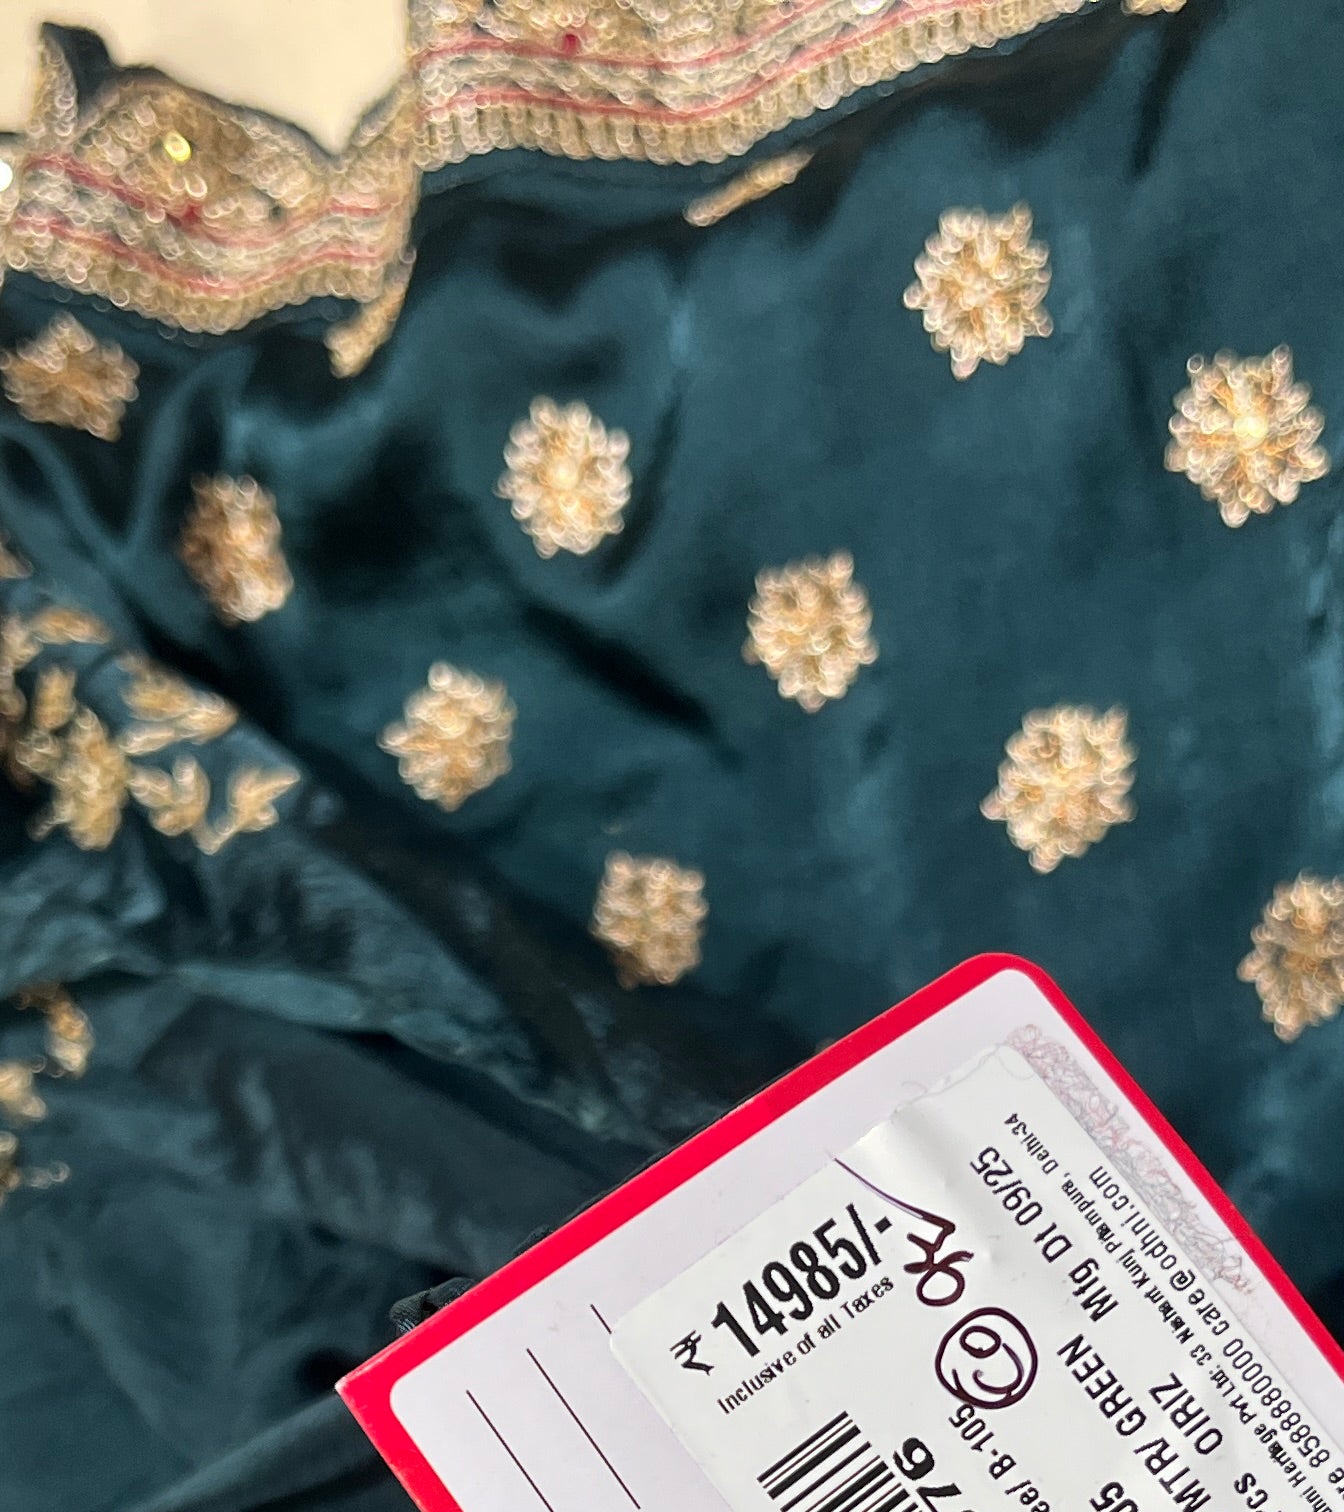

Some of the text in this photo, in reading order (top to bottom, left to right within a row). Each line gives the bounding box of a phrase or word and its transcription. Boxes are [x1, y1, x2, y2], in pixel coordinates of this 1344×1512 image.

[1003, 1111, 1059, 1175] Delhi-34
[968, 1145, 1043, 1227] 09/25
[1032, 1220, 1073, 1264] Dt
[1117, 1247, 1151, 1290] Kunj
[709, 1201, 893, 1358] 14985/-
[1066, 1256, 1120, 1323] Mfg
[715, 1275, 894, 1415] Inclusive of all Taxes
[1189, 1342, 1213, 1367] 33
[1055, 1332, 1148, 1437] GREEN
[1221, 1337, 1331, 1469] 8588880000
